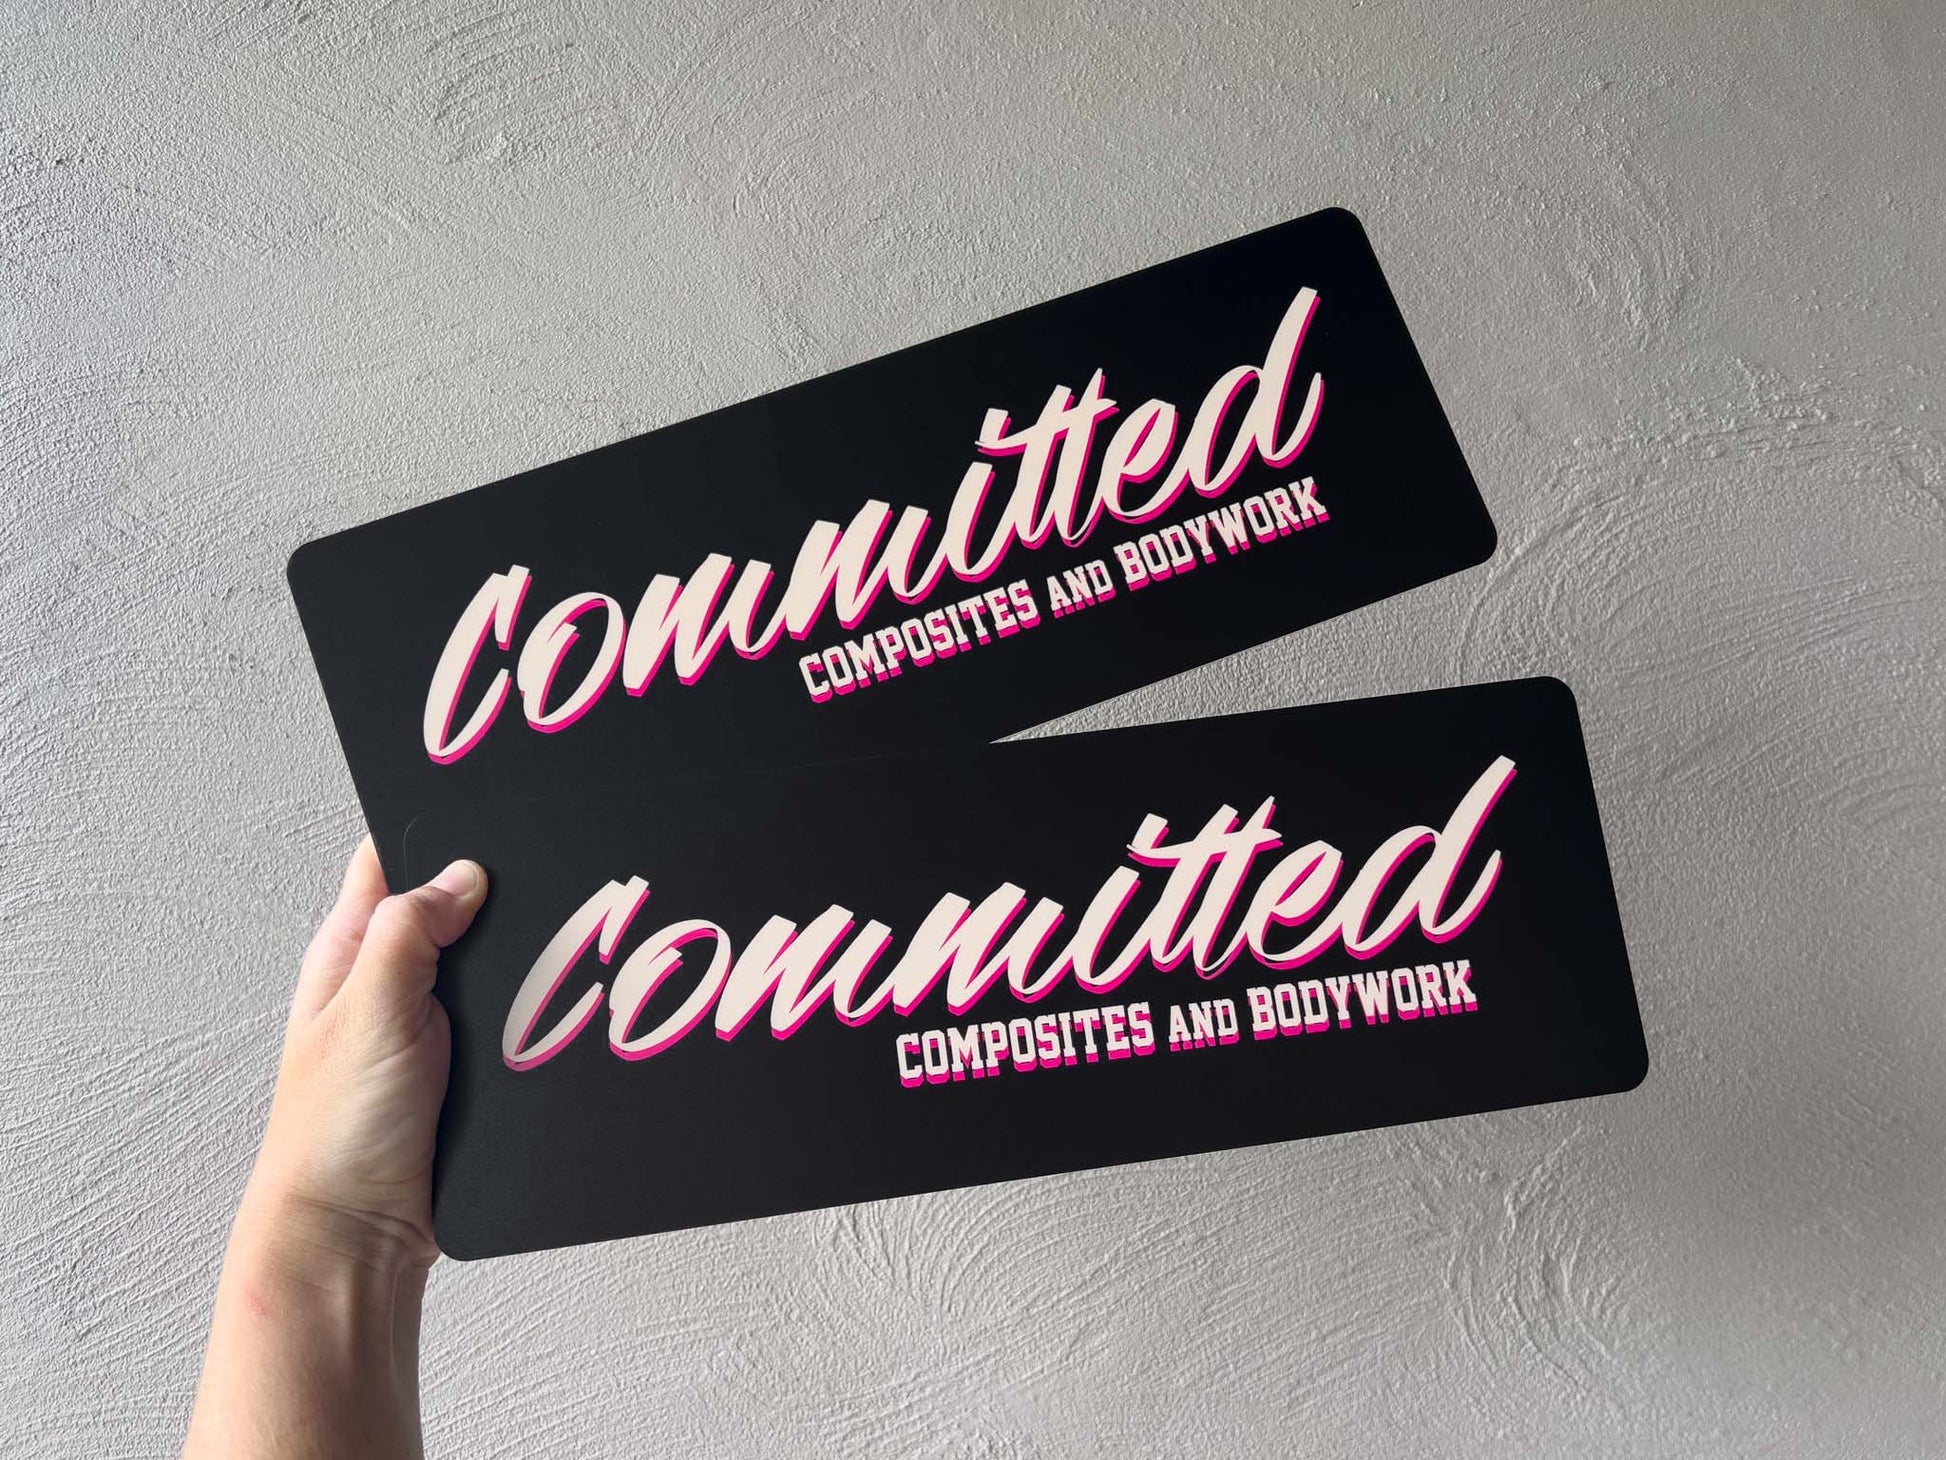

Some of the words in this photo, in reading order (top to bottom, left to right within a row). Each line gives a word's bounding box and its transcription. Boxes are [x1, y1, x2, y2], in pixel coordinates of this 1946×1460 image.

[423, 287, 1326, 765] Committed
[799, 579, 1041, 704] COMPOSITES
[1047, 560, 1117, 618] AND
[1113, 476, 1331, 591] BODYWORK
[502, 755, 1518, 1072] Committed
[896, 1002, 1156, 1089] COMPOSITES
[1168, 999, 1240, 1052] AND
[1247, 960, 1479, 1041] BODYWORK
